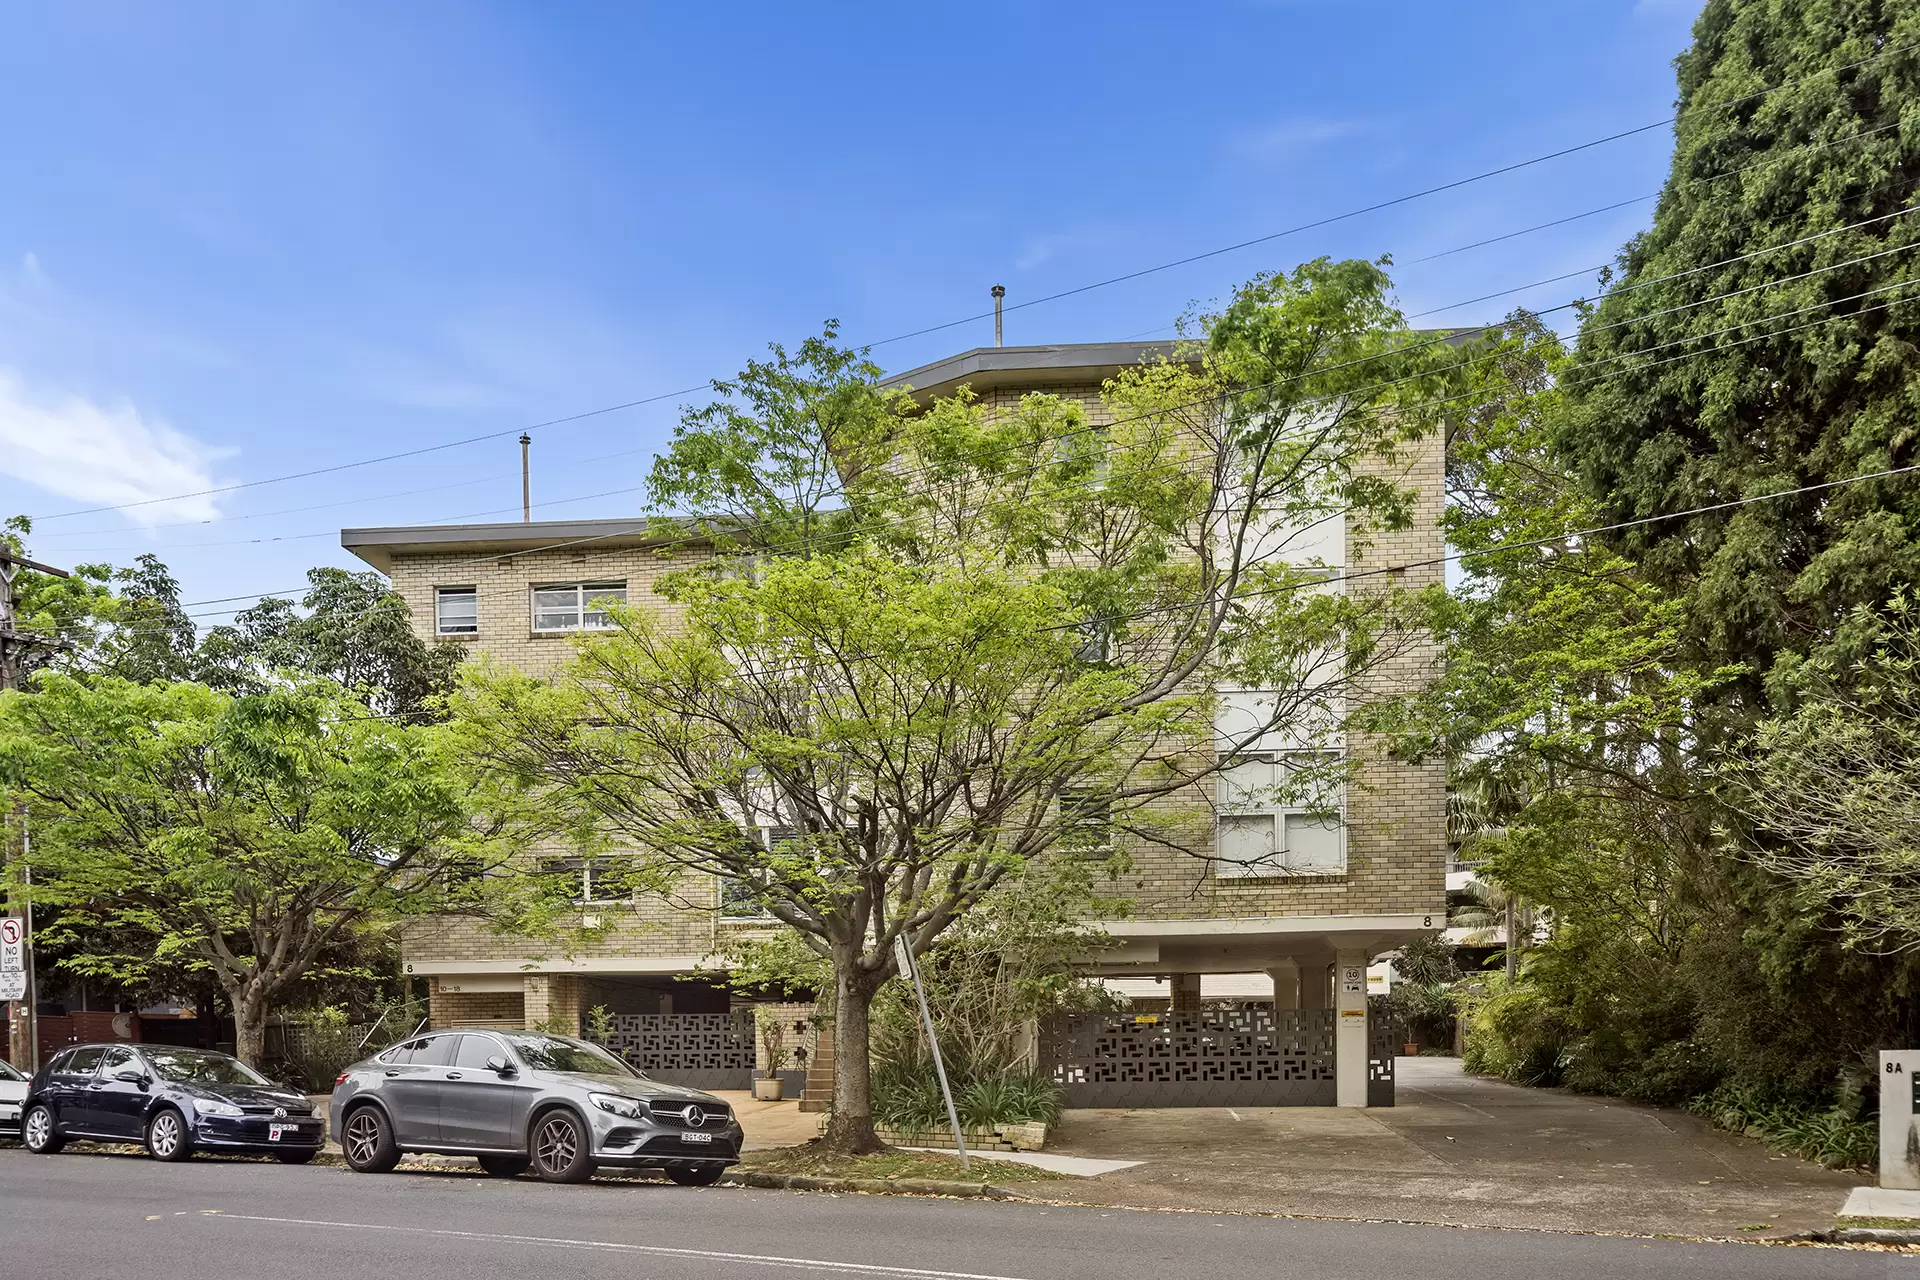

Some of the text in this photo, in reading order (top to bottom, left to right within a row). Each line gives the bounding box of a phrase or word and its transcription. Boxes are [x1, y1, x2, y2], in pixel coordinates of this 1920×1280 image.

[1423, 916, 1432, 927] 8
[6, 947, 17, 955] NO
[407, 964, 413, 973] 8
[1886, 1062, 1903, 1073] 8A
[271, 1130, 279, 1139] P
